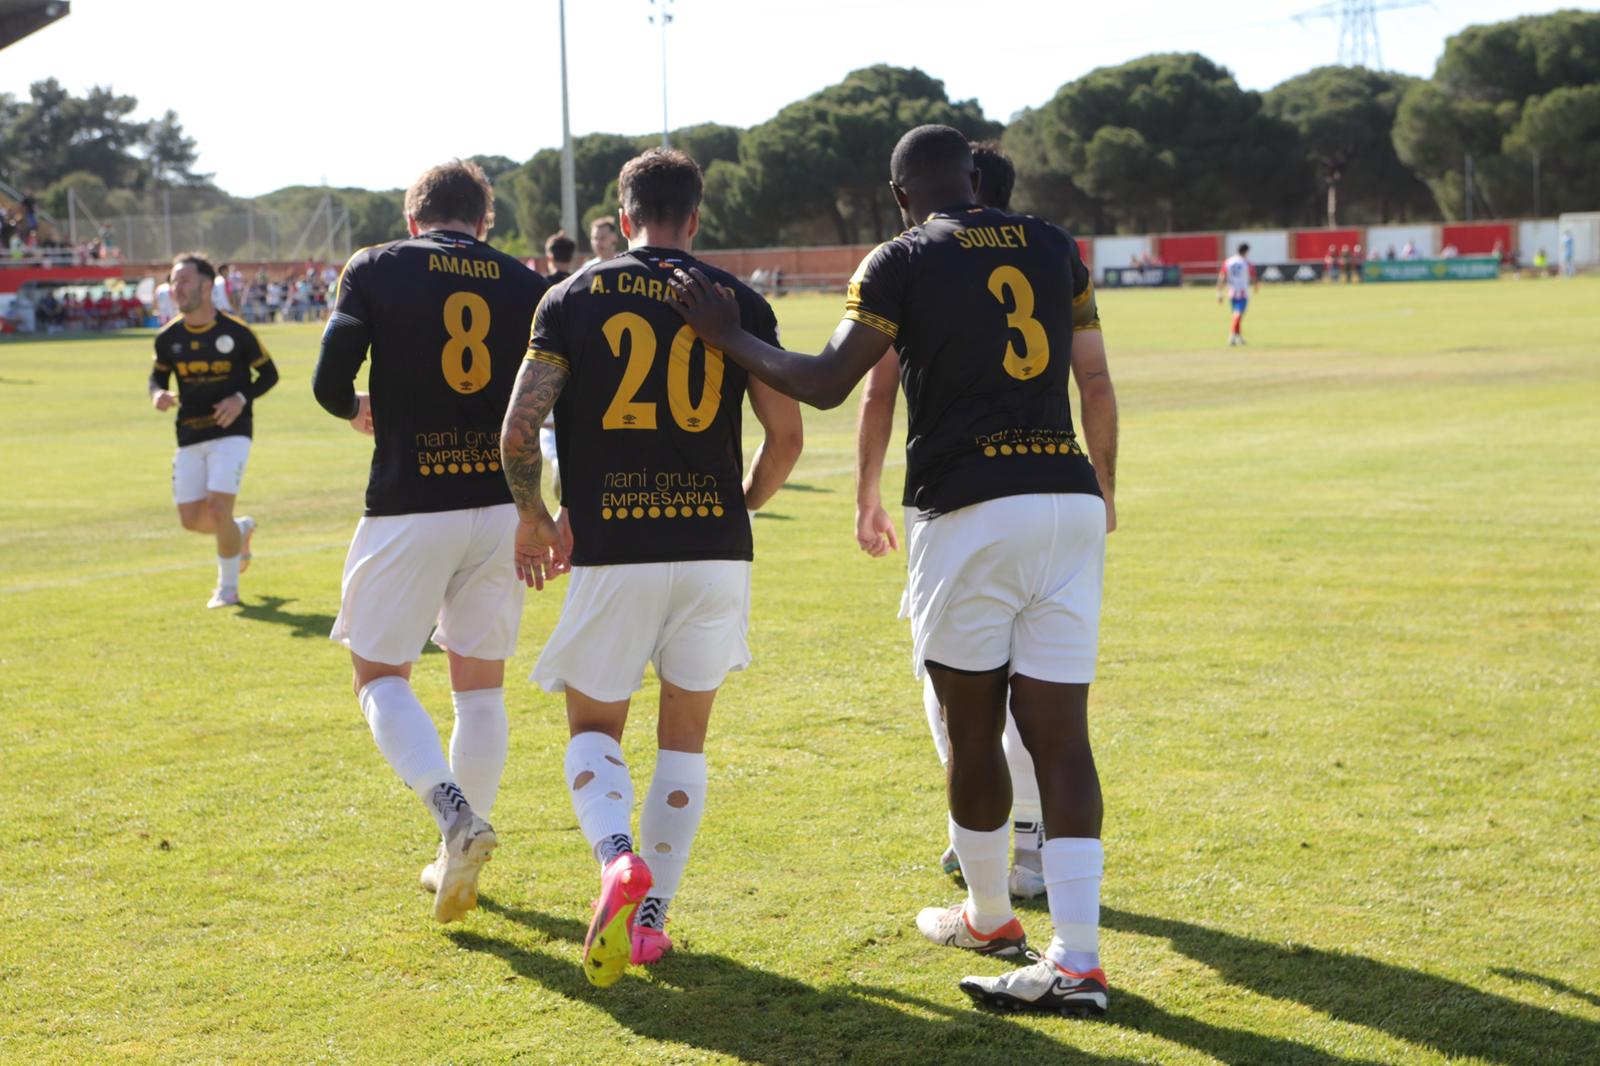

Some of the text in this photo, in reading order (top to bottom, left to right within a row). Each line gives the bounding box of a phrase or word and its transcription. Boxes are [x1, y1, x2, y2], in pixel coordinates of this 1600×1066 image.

[953, 224, 1028, 249] SOULEY
[429, 254, 500, 280] AMARO
[590, 273, 611, 295] A.
[988, 264, 1050, 381] 3
[441, 291, 492, 395] 8
[601, 312, 725, 432] 20
[416, 427, 458, 448] nani
[417, 448, 501, 465] EMPRESAR
[603, 467, 647, 488] nani
[602, 491, 723, 507] EMPRESARIAL
